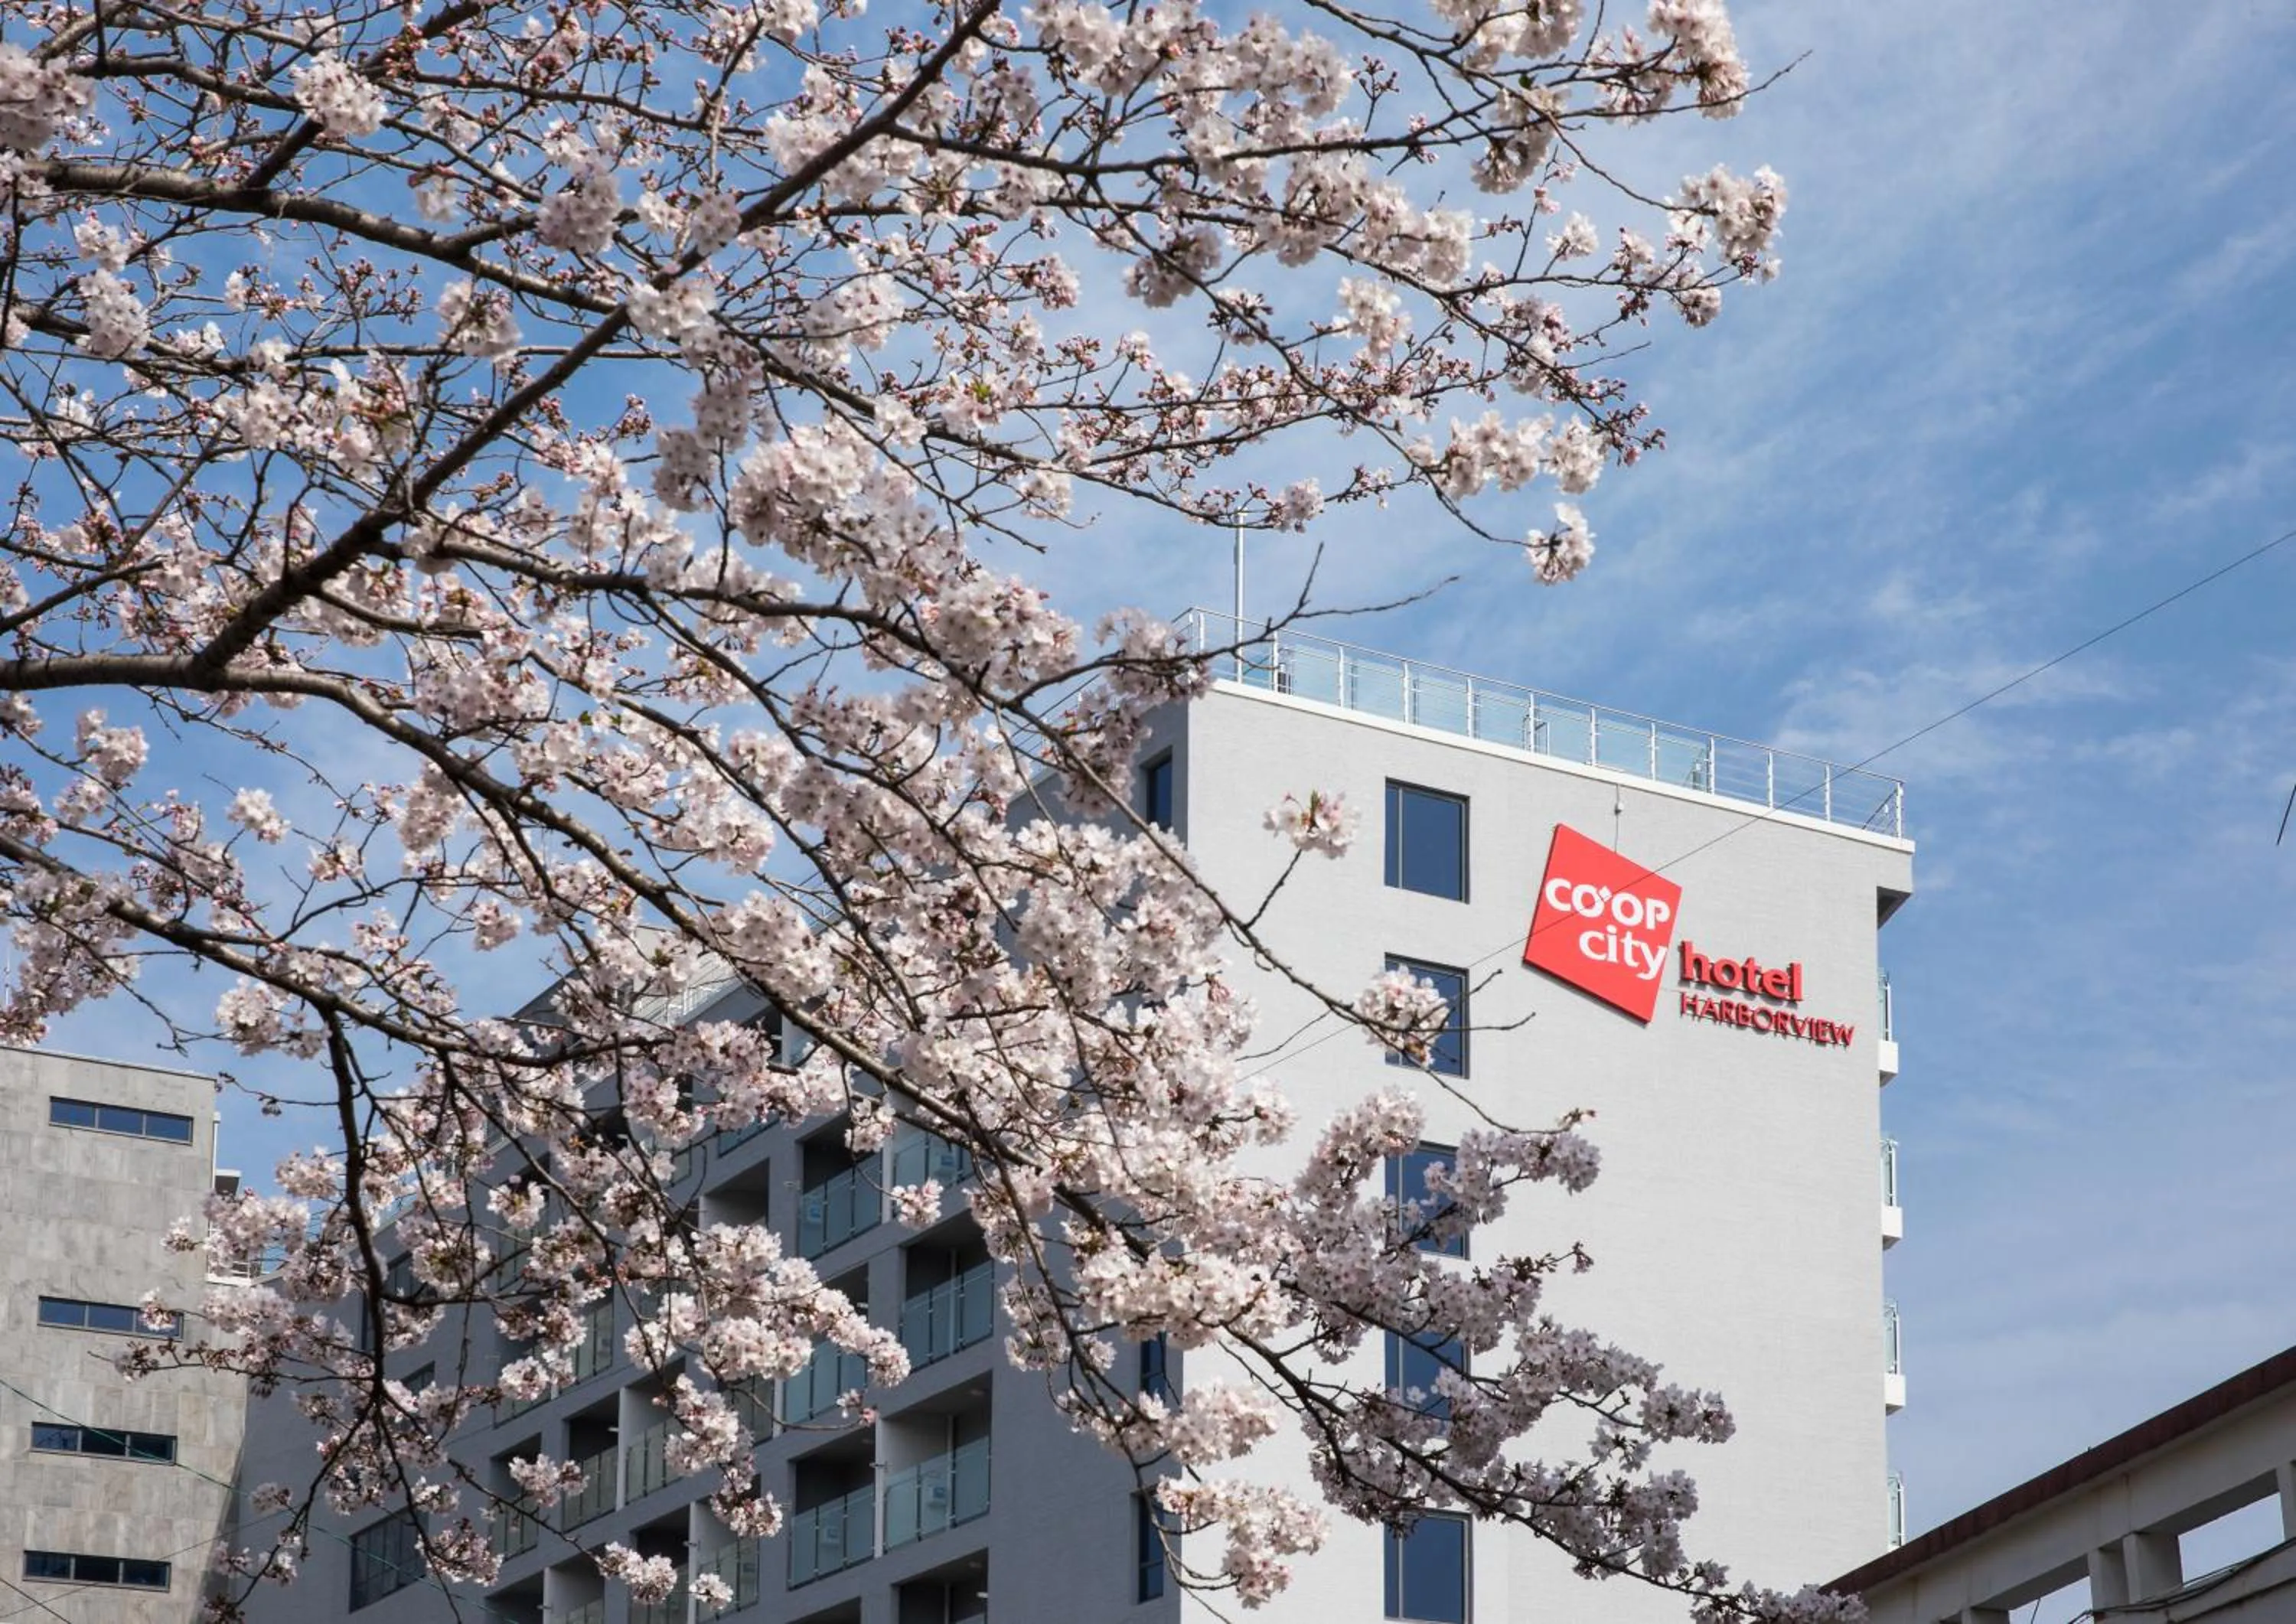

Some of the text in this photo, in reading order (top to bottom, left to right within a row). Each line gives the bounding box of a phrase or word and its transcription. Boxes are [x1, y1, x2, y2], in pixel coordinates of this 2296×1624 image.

[1579, 925, 1668, 980] city
[1681, 941, 1803, 1002] hotel
[1681, 993, 1854, 1046] HARBORVIEW
